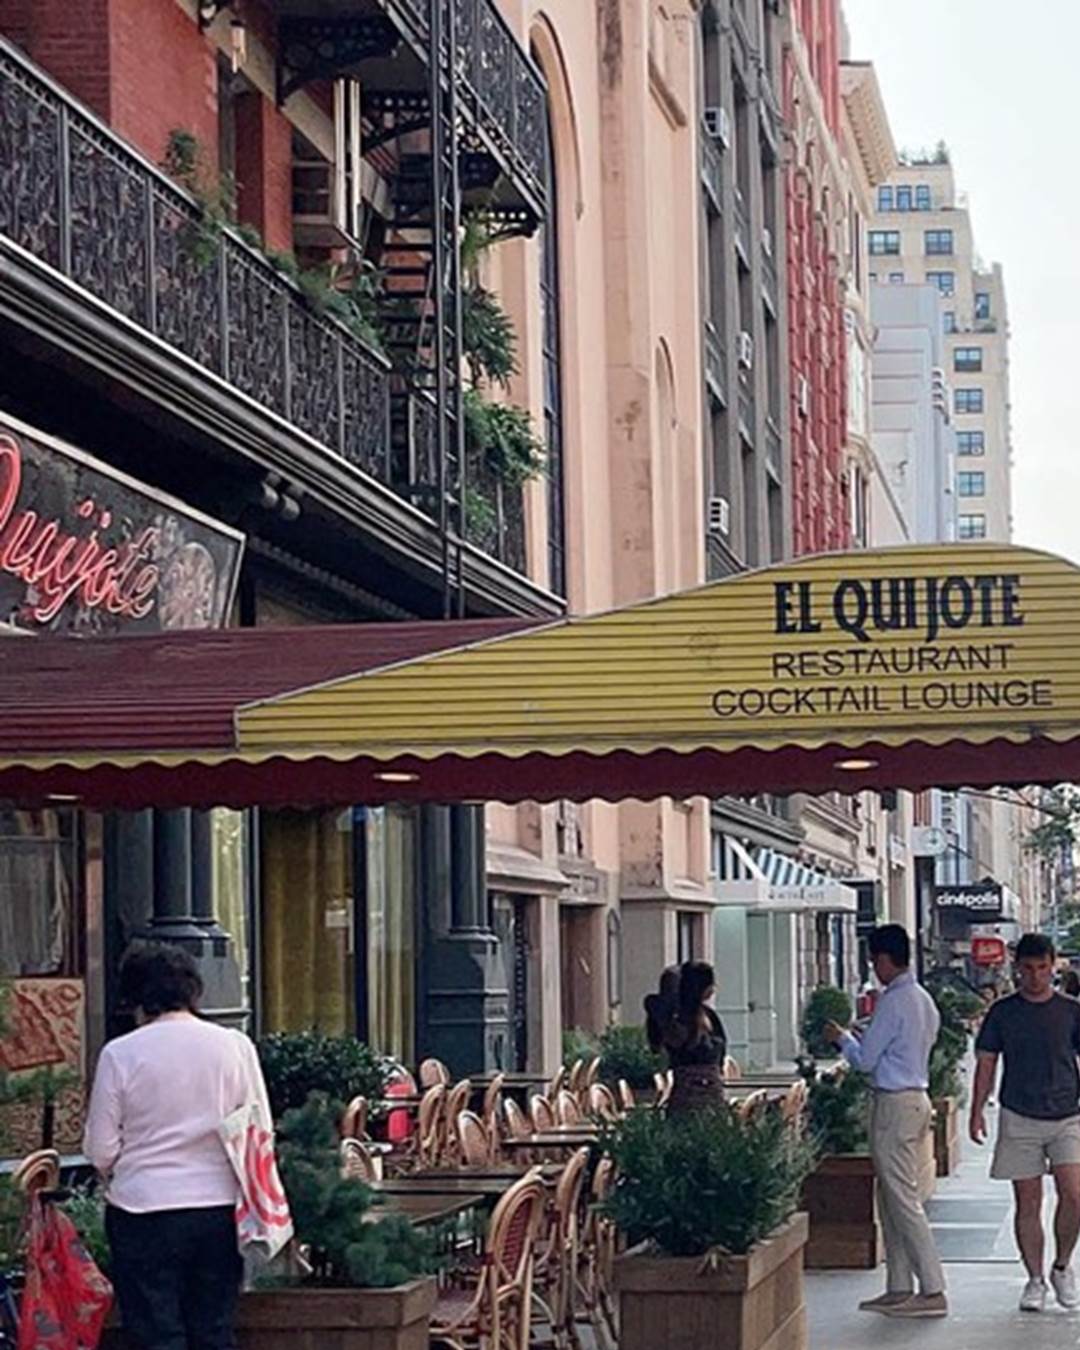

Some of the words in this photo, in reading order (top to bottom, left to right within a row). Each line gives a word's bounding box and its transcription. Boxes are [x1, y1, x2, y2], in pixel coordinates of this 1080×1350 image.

[773, 580, 822, 635] EL
[832, 573, 1025, 643] QUIJOTE
[771, 643, 1015, 678] RESTAURANT
[711, 685, 890, 717] COCKTAIL
[902, 679, 1053, 710] LOUNGE
